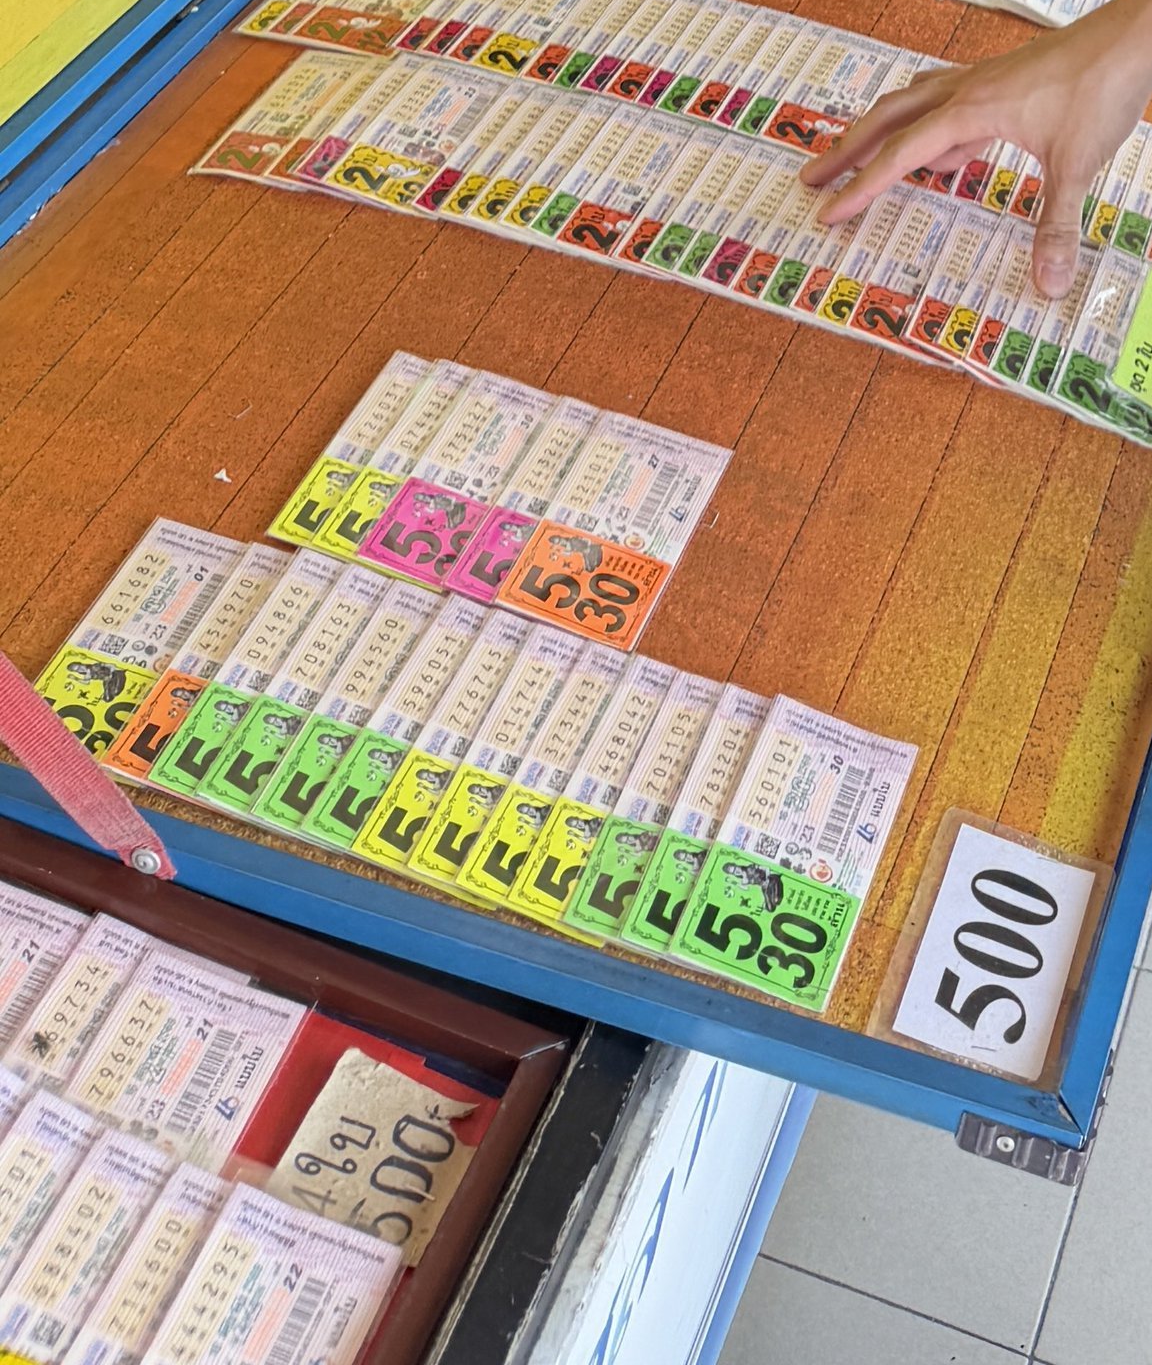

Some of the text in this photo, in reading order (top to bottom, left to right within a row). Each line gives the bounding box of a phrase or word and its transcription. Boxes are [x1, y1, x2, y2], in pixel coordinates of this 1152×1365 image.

[343, 165, 386, 193] 2
[1135, 359, 1149, 371] 2
[646, 453, 659, 470] 27
[196, 566, 209, 582] 01
[379, 520, 443, 565] 5
[100, 553, 160, 625] 661682
[199, 579, 254, 652] 454970
[247, 585, 302, 660] 094866
[519, 565, 582, 610] 5
[574, 573, 641, 633] 30
[299, 602, 349, 676] 708163
[346, 618, 399, 695] 994560
[402, 635, 456, 710] 596051
[449, 648, 502, 726] 776745
[496, 665, 544, 744] 014744
[544, 680, 594, 757] 373443
[598, 695, 647, 772] 468042
[646, 712, 692, 791] 703105
[701, 727, 742, 806] 783204
[750, 739, 792, 821] 560101
[800, 755, 844, 842] 23 30
[22, 940, 39, 962] 21
[695, 901, 763, 961] 5
[757, 912, 827, 989] 30
[935, 869, 1058, 1044] 500
[89, 999, 155, 1099] 796637
[196, 1018, 214, 1041] 21
[347, 1114, 455, 1245] 500
[284, 1264, 303, 1291] 22
